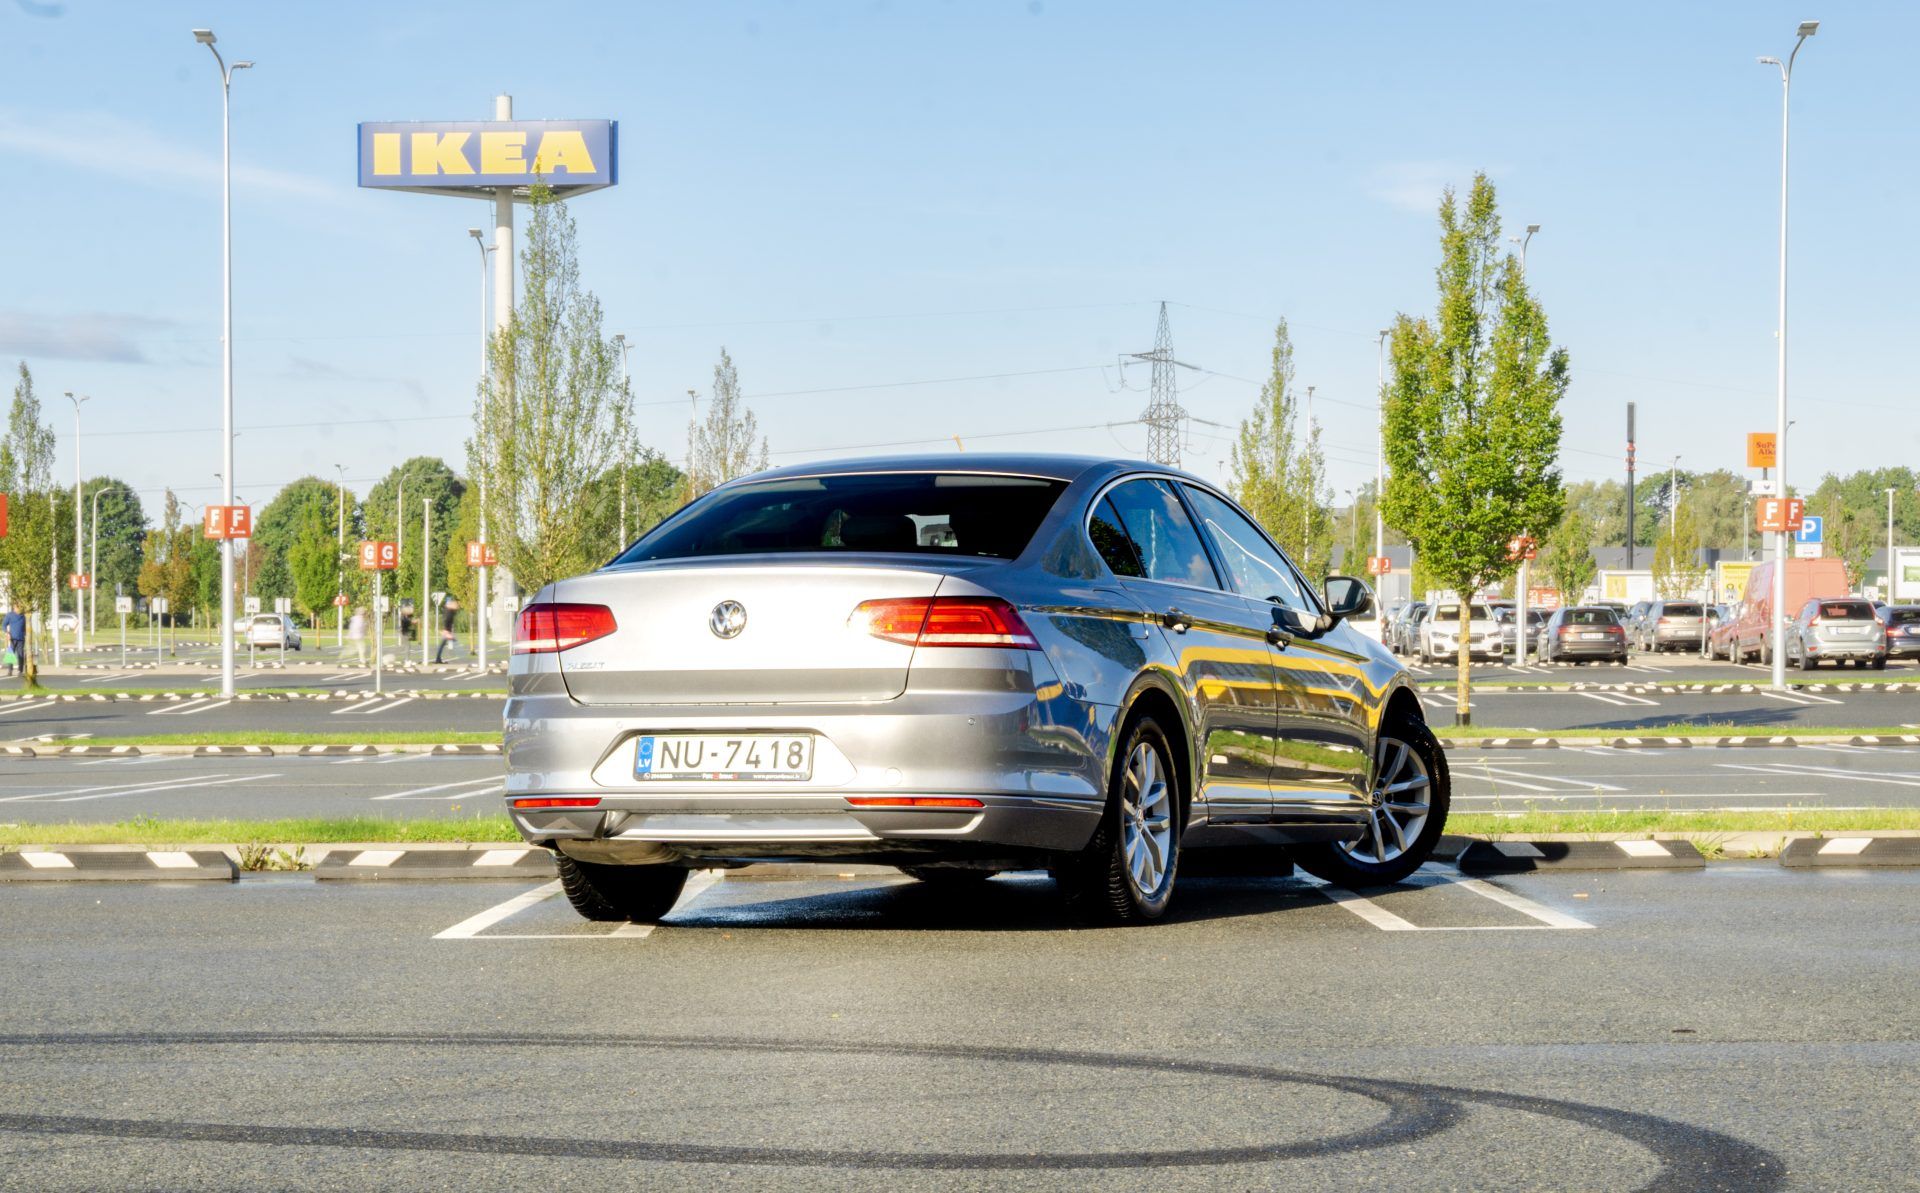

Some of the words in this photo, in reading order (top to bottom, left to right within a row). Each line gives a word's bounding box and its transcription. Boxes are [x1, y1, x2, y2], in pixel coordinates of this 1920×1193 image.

[373, 131, 597, 175] IKEA
[211, 509, 220, 527] F
[232, 509, 244, 527] F
[1766, 502, 1778, 520] F
[1790, 502, 1798, 520] F
[1801, 520, 1816, 540] P
[364, 545, 374, 559] G
[382, 545, 393, 559] G
[638, 758, 651, 768] LV
[660, 741, 804, 769] NU-7418
